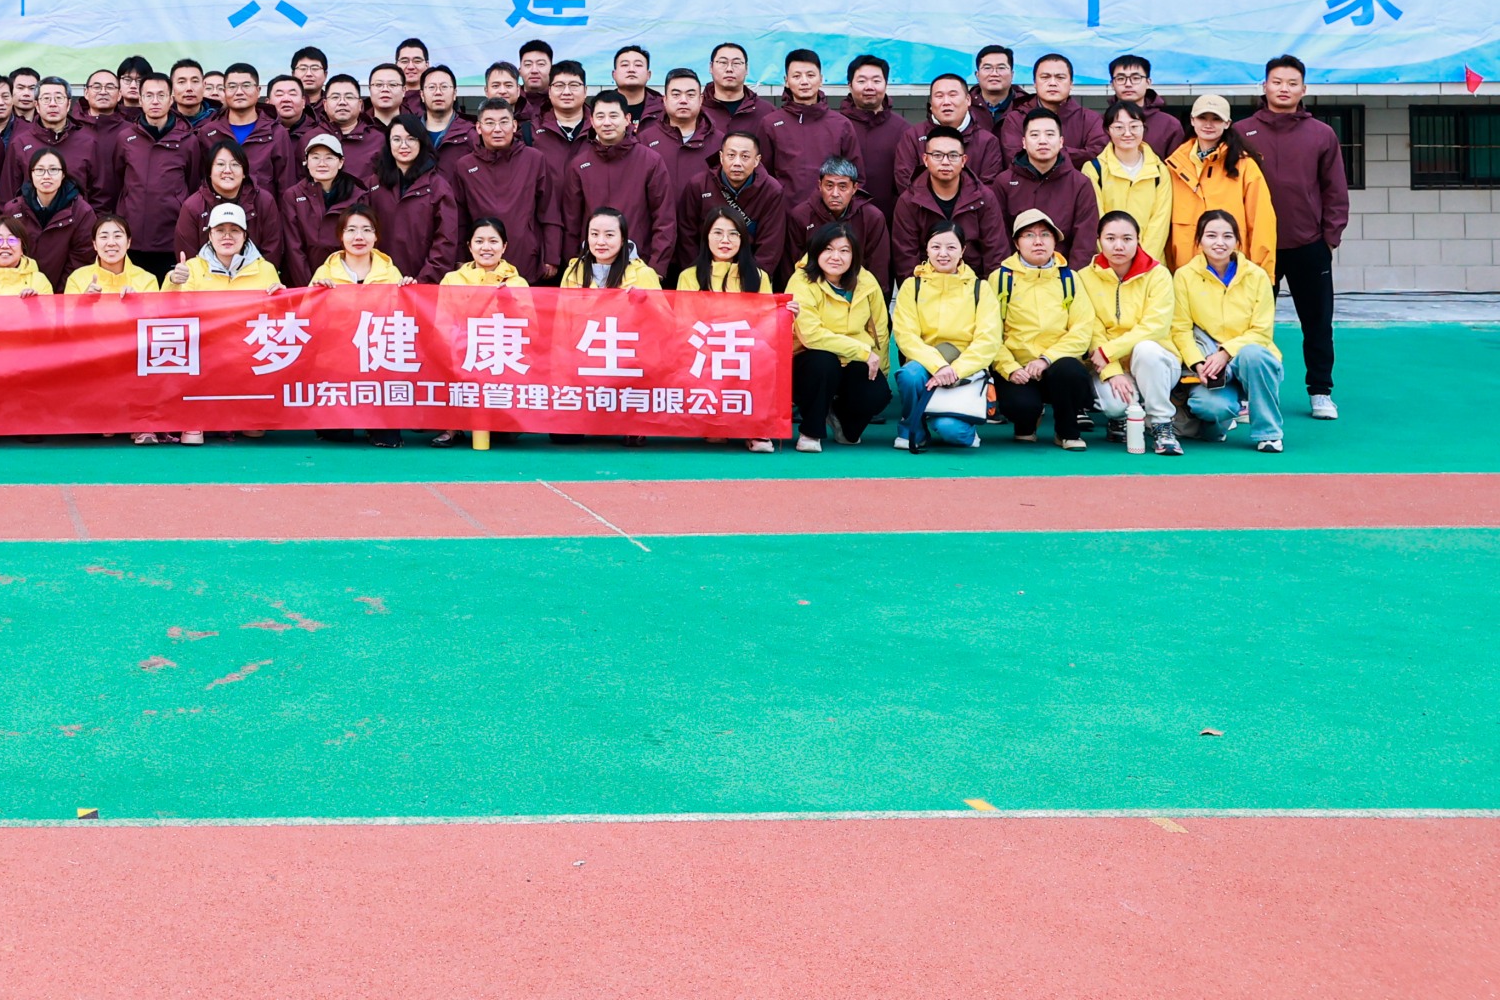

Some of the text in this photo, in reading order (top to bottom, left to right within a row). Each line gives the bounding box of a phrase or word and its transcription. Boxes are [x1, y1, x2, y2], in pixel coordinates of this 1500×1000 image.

[136, 311, 756, 381] 圆梦健康生活
